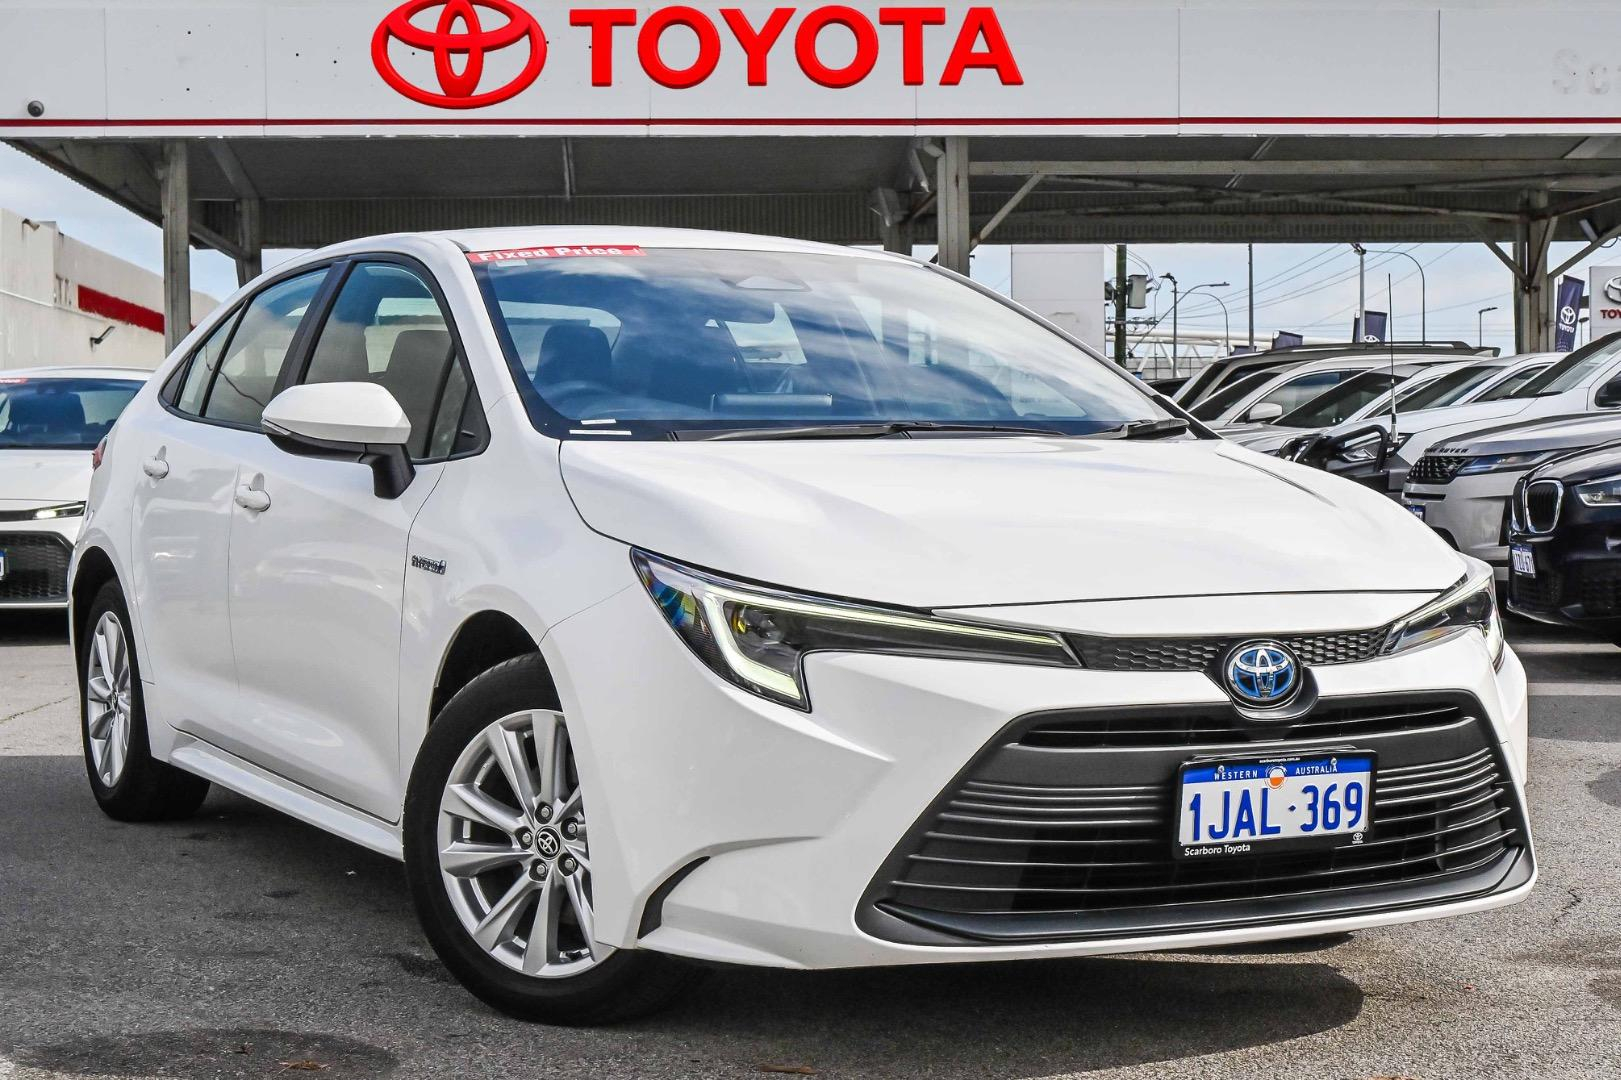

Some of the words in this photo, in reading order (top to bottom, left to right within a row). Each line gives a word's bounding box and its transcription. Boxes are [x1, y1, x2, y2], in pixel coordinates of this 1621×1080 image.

[569, 5, 1024, 89] TOYOTA
[478, 248, 549, 261] Fixed
[554, 247, 624, 257] Price
[1214, 769, 1258, 781] WESTERN
[1295, 764, 1338, 775] AUSTRALIA
[1189, 787, 1281, 842] 1JAL
[1300, 781, 1363, 833] 369
[1184, 846, 1222, 857] Scarboro
[1224, 844, 1251, 855] Toyota
